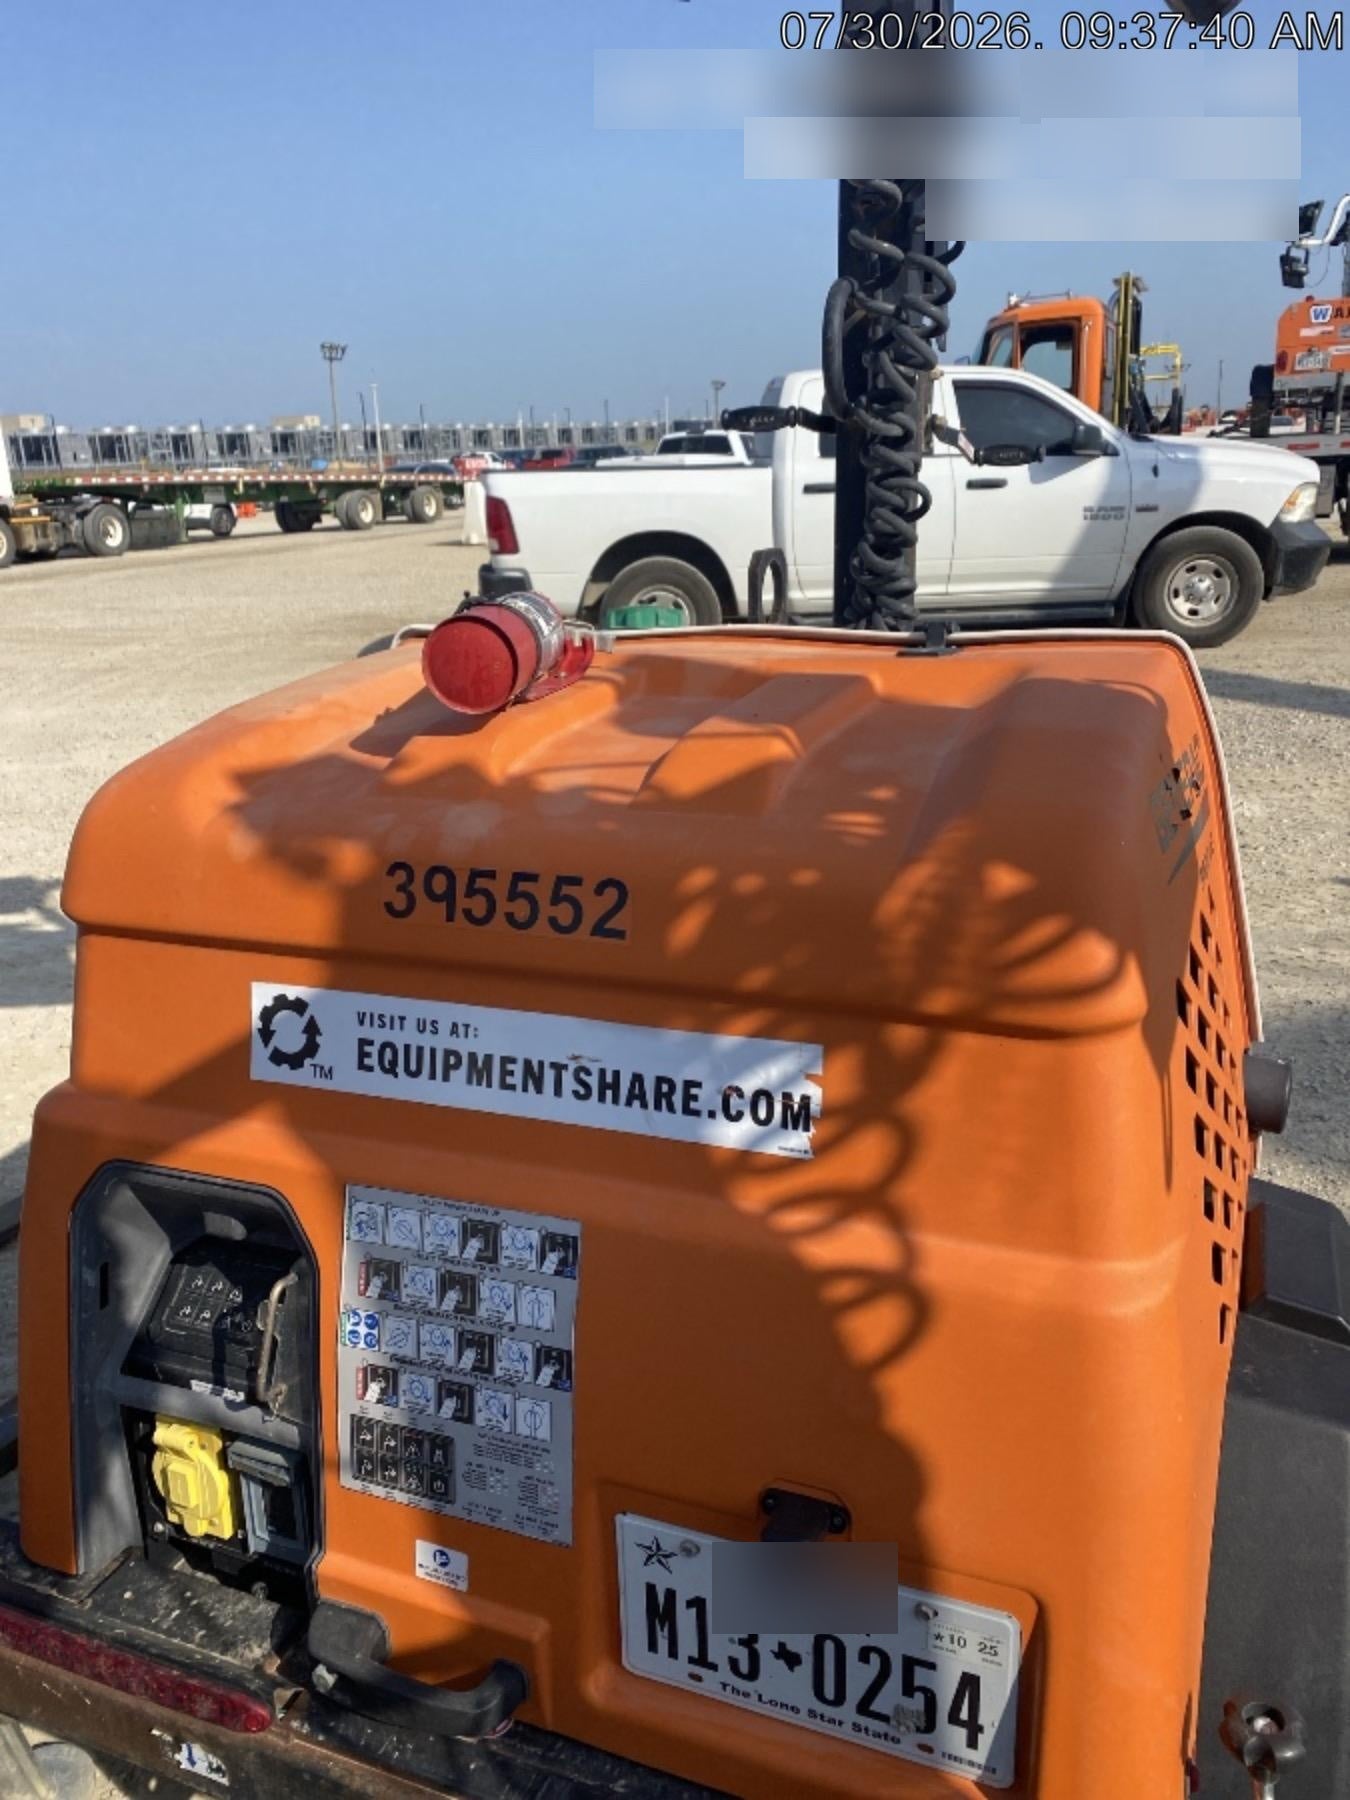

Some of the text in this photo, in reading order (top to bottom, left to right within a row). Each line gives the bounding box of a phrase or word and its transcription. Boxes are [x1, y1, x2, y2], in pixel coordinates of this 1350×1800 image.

[1311, 305, 1350, 321] WA
[384, 861, 629, 941] 395552
[356, 1010, 479, 1039] VISIT US AT:
[309, 1063, 333, 1081] TM
[356, 1037, 812, 1133] EQUIPMENTSHARE.COM
[948, 1632, 968, 1650] 10
[976, 1640, 1000, 1658] 25
[719, 1681, 751, 1699] The
[807, 1708, 845, 1728] Star
[851, 1721, 901, 1745] State
[812, 1633, 984, 1750] 0254
